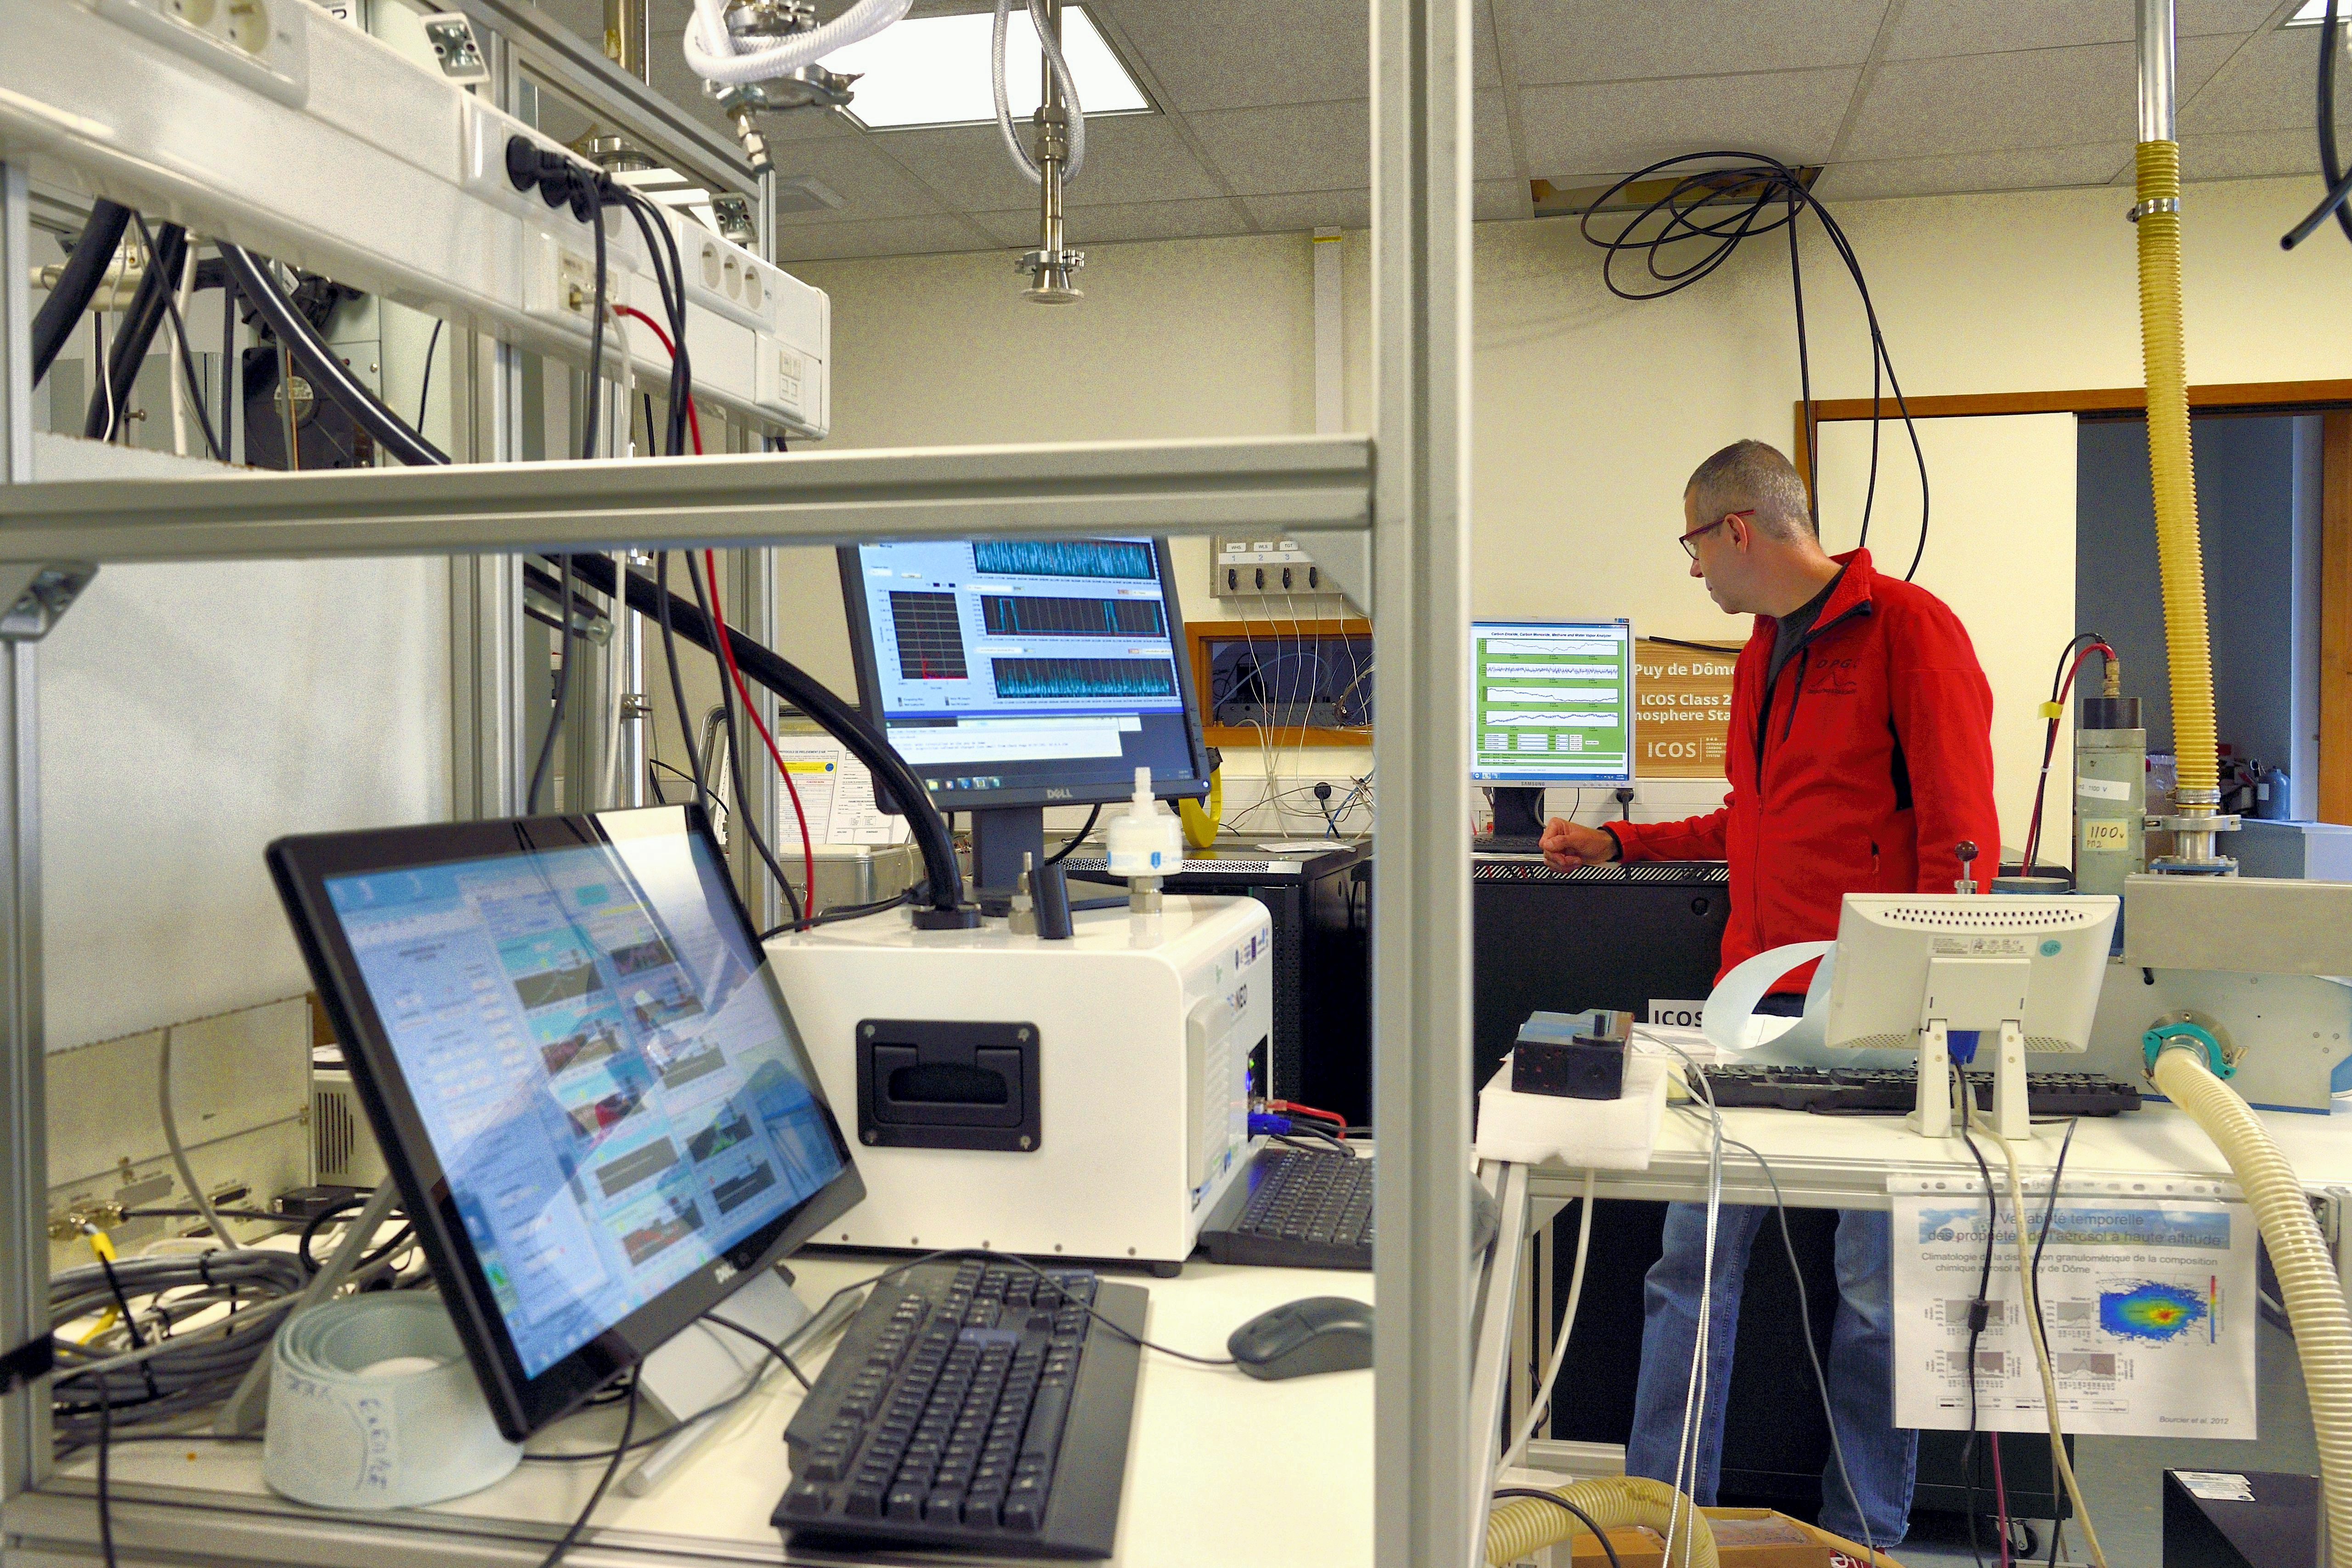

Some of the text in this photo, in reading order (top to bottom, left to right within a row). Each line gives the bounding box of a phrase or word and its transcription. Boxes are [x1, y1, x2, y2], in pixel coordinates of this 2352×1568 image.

[1668, 663, 1688, 675] de
[1641, 693, 1731, 706] ICOS Class 2
[1708, 710, 1730, 721] Sta
[1648, 742, 1696, 757] ICOS
[1046, 788, 1074, 799] DELL
[2091, 826, 2118, 838] 1100
[1655, 1010, 1702, 1027] ICOS
[2070, 1213, 2144, 1227] temporelle
[1929, 1230, 1952, 1241] des
[2125, 1231, 2163, 1242] haute
[2169, 1232, 2222, 1245] altitude
[1922, 1252, 1977, 1262] Climatologie
[2133, 1253, 2145, 1262] de
[2160, 1255, 2218, 1266] composition
[1935, 1264, 1976, 1273] chimique
[2062, 1264, 2090, 1274] Dôme
